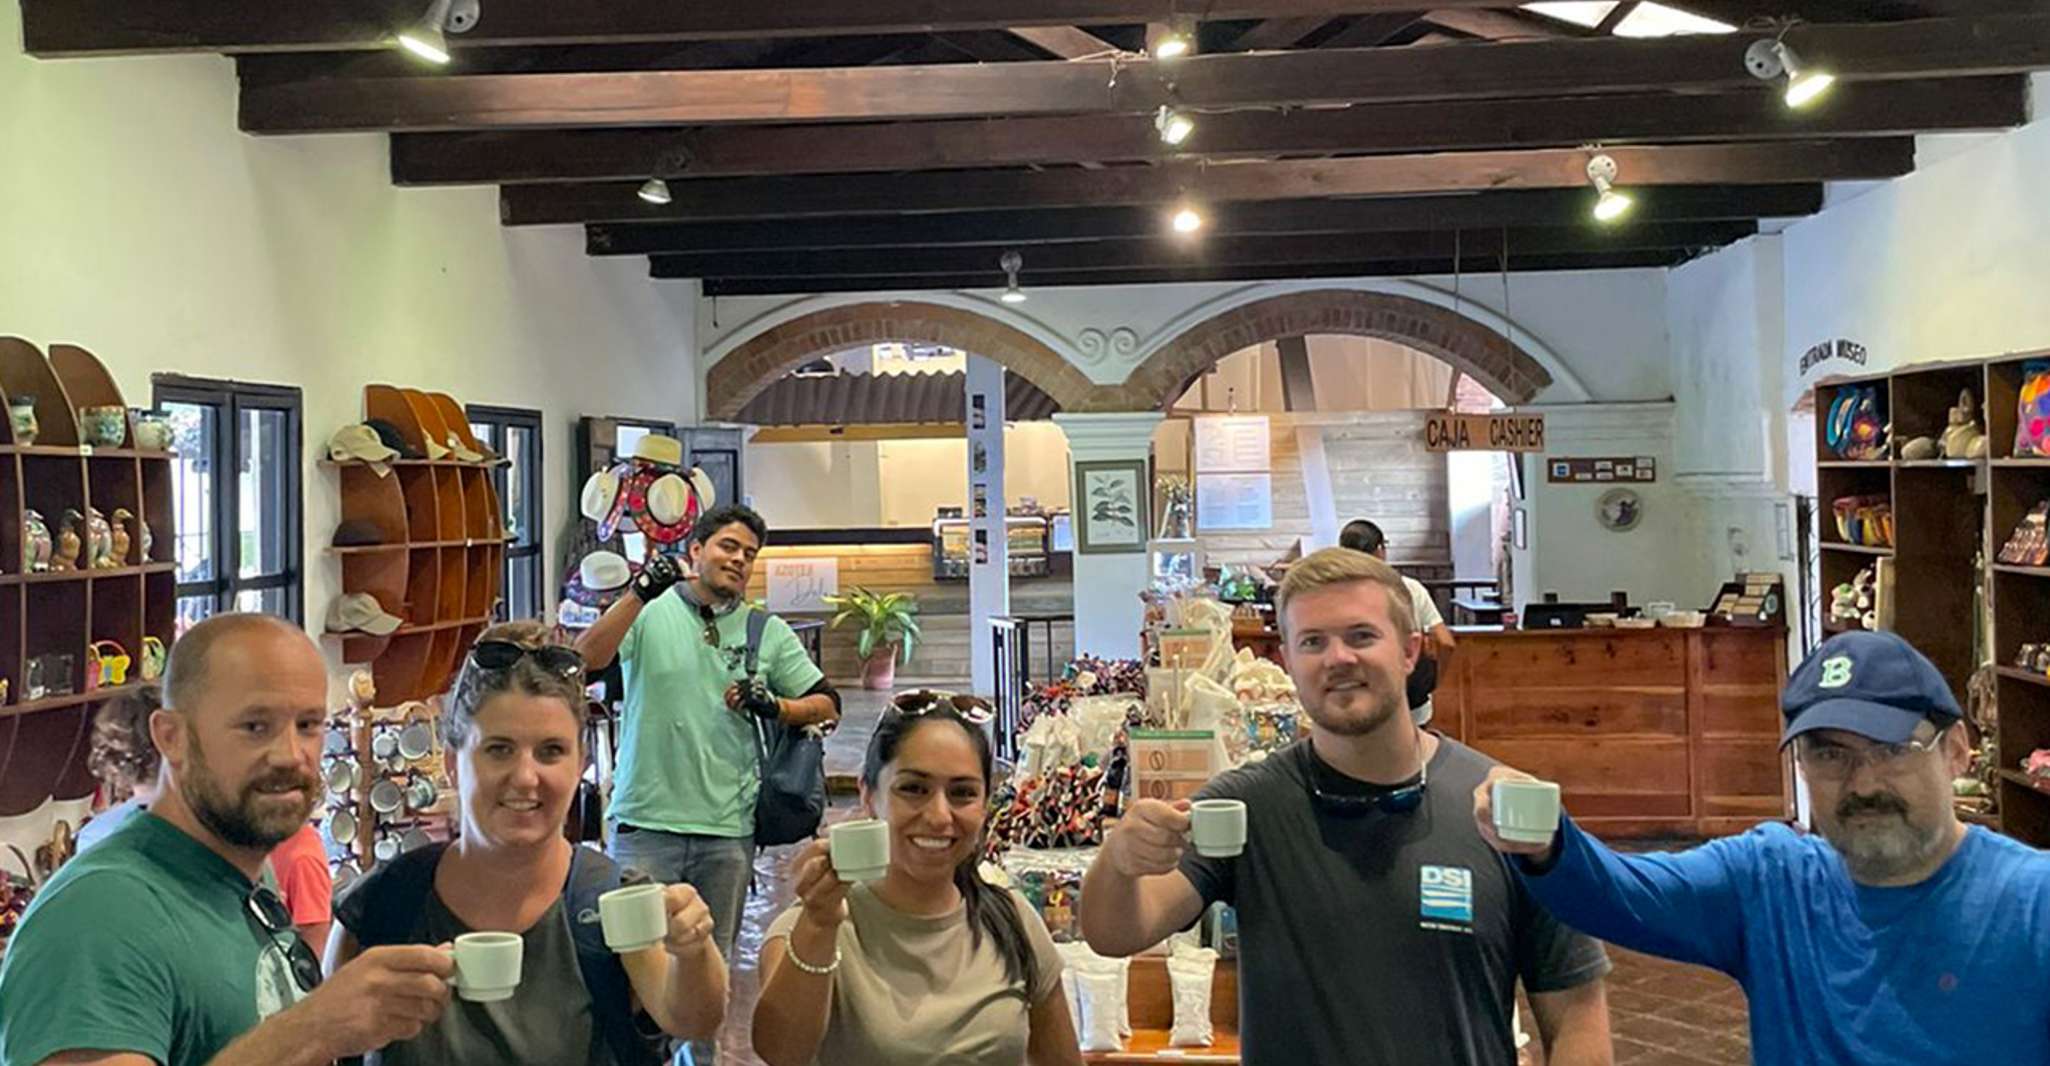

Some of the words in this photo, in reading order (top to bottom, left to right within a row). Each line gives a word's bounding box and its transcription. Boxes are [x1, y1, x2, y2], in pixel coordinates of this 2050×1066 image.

[1837, 339, 1866, 366] MUSEO
[1427, 419, 1470, 447] CAJA
[1490, 418, 1544, 447] CASHIER
[1818, 656, 1852, 688] B
[1421, 866, 1472, 888] DSI
